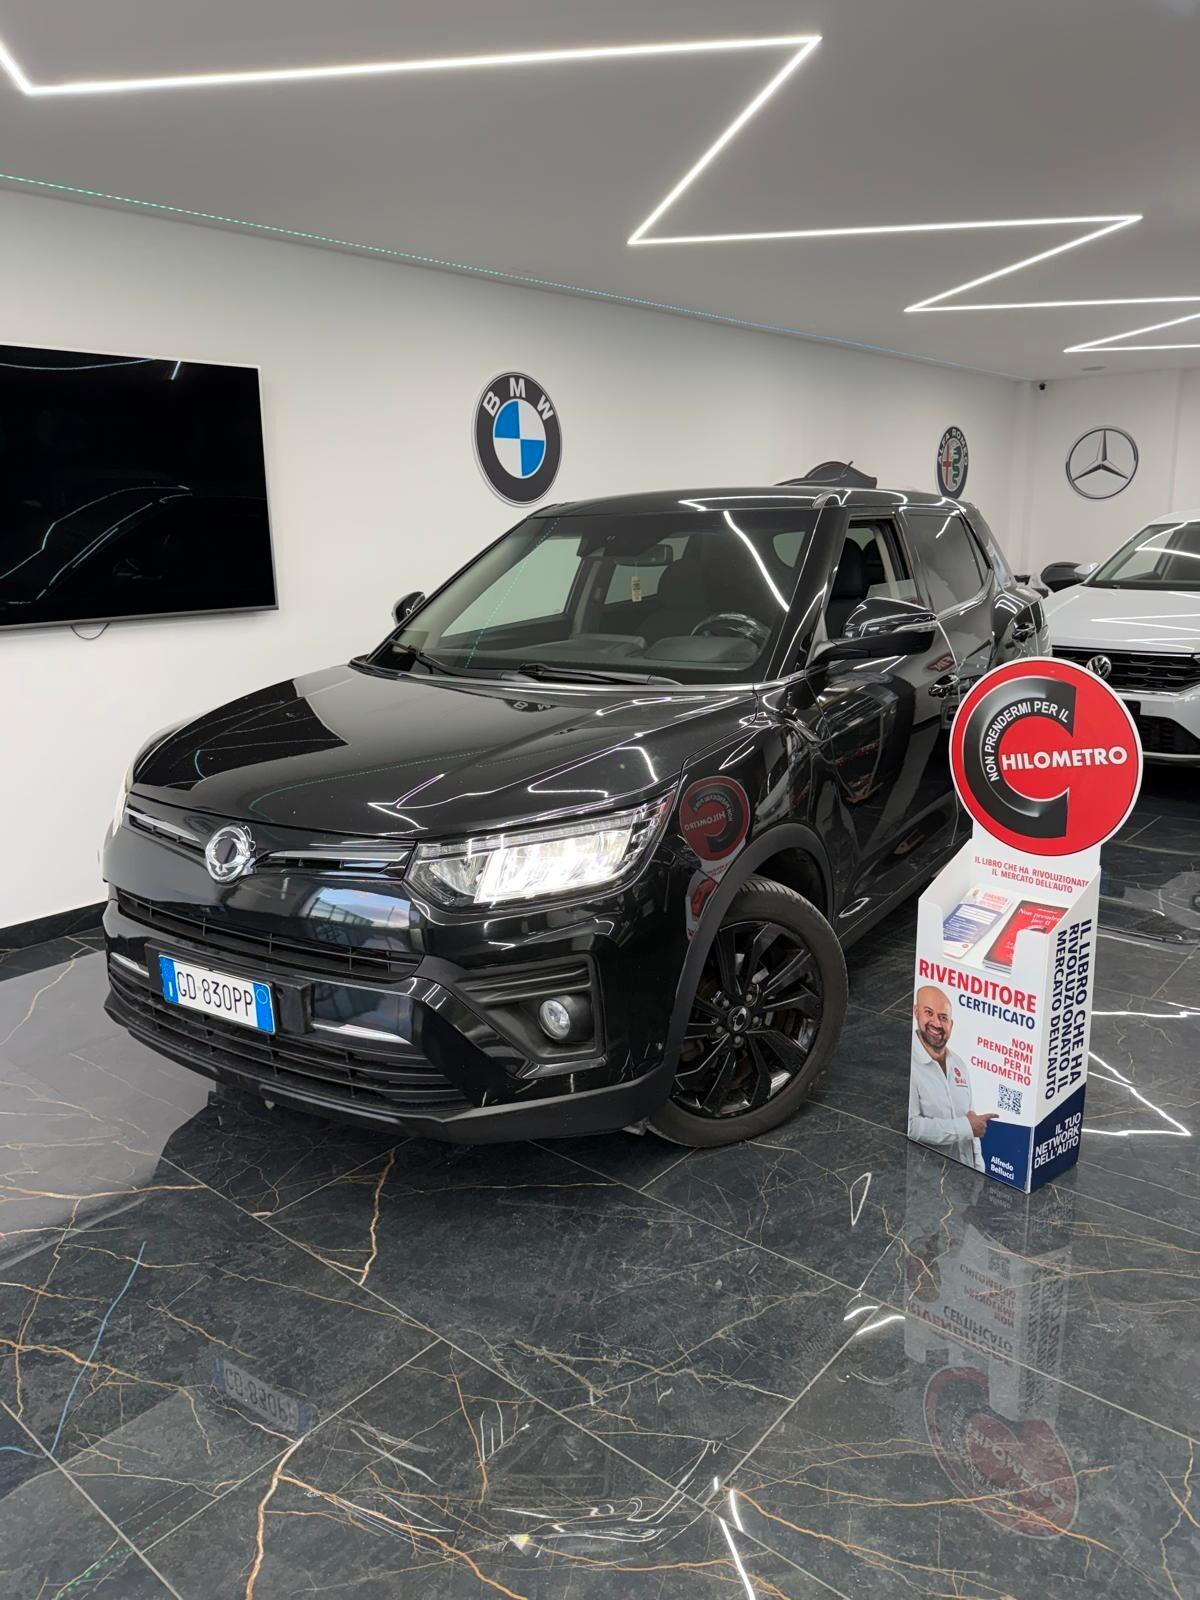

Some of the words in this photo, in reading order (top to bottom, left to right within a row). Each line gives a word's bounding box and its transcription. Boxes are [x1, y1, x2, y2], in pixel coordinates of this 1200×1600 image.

[482, 377, 554, 421] BMW
[1033, 700, 1058, 717] PER
[1058, 708, 1069, 723] IL
[984, 701, 1032, 754] PRENDERMI
[985, 756, 1000, 782] NON
[1001, 746, 1128, 771] HILOMETRO
[974, 855, 981, 864] IL
[982, 857, 1003, 869] LIBRO
[1003, 861, 1017, 872] CHE
[1018, 864, 1029, 875] HA
[991, 868, 998, 877] IL
[1001, 870, 1034, 885] MERCATO
[1035, 877, 1073, 894] DELL'AUTO
[1080, 919, 1092, 941] IL
[1051, 929, 1068, 1012] MERCATO
[1075, 941, 1091, 1006] LIBRO
[176, 971, 197, 1000] GD
[201, 978, 253, 1017] 830PP
[919, 958, 1037, 1014] RIVENDITORE
[1058, 923, 1080, 1072] RIVOLUZIONATO
[958, 994, 1036, 1030] CERTIFICATO
[1072, 1010, 1086, 1049] CHE
[977, 1036, 1033, 1064] PRENDERMI
[1011, 1038, 1034, 1054] NON
[1045, 1015, 1061, 1100] DELL'AUTO
[970, 1056, 1031, 1087] CHILOMETRO
[1003, 1057, 1022, 1071] PER
[1023, 1063, 1032, 1076] IL
[1069, 1053, 1083, 1086] HA
[1057, 1075, 1068, 1093] IL
[1055, 1121, 1063, 1134] IL
[1064, 1111, 1082, 1129] TUO
[1034, 1135, 1079, 1169] DELL'AUTO
[1035, 1128, 1080, 1158] NETWORK
[991, 1155, 1014, 1172] Alfredo
